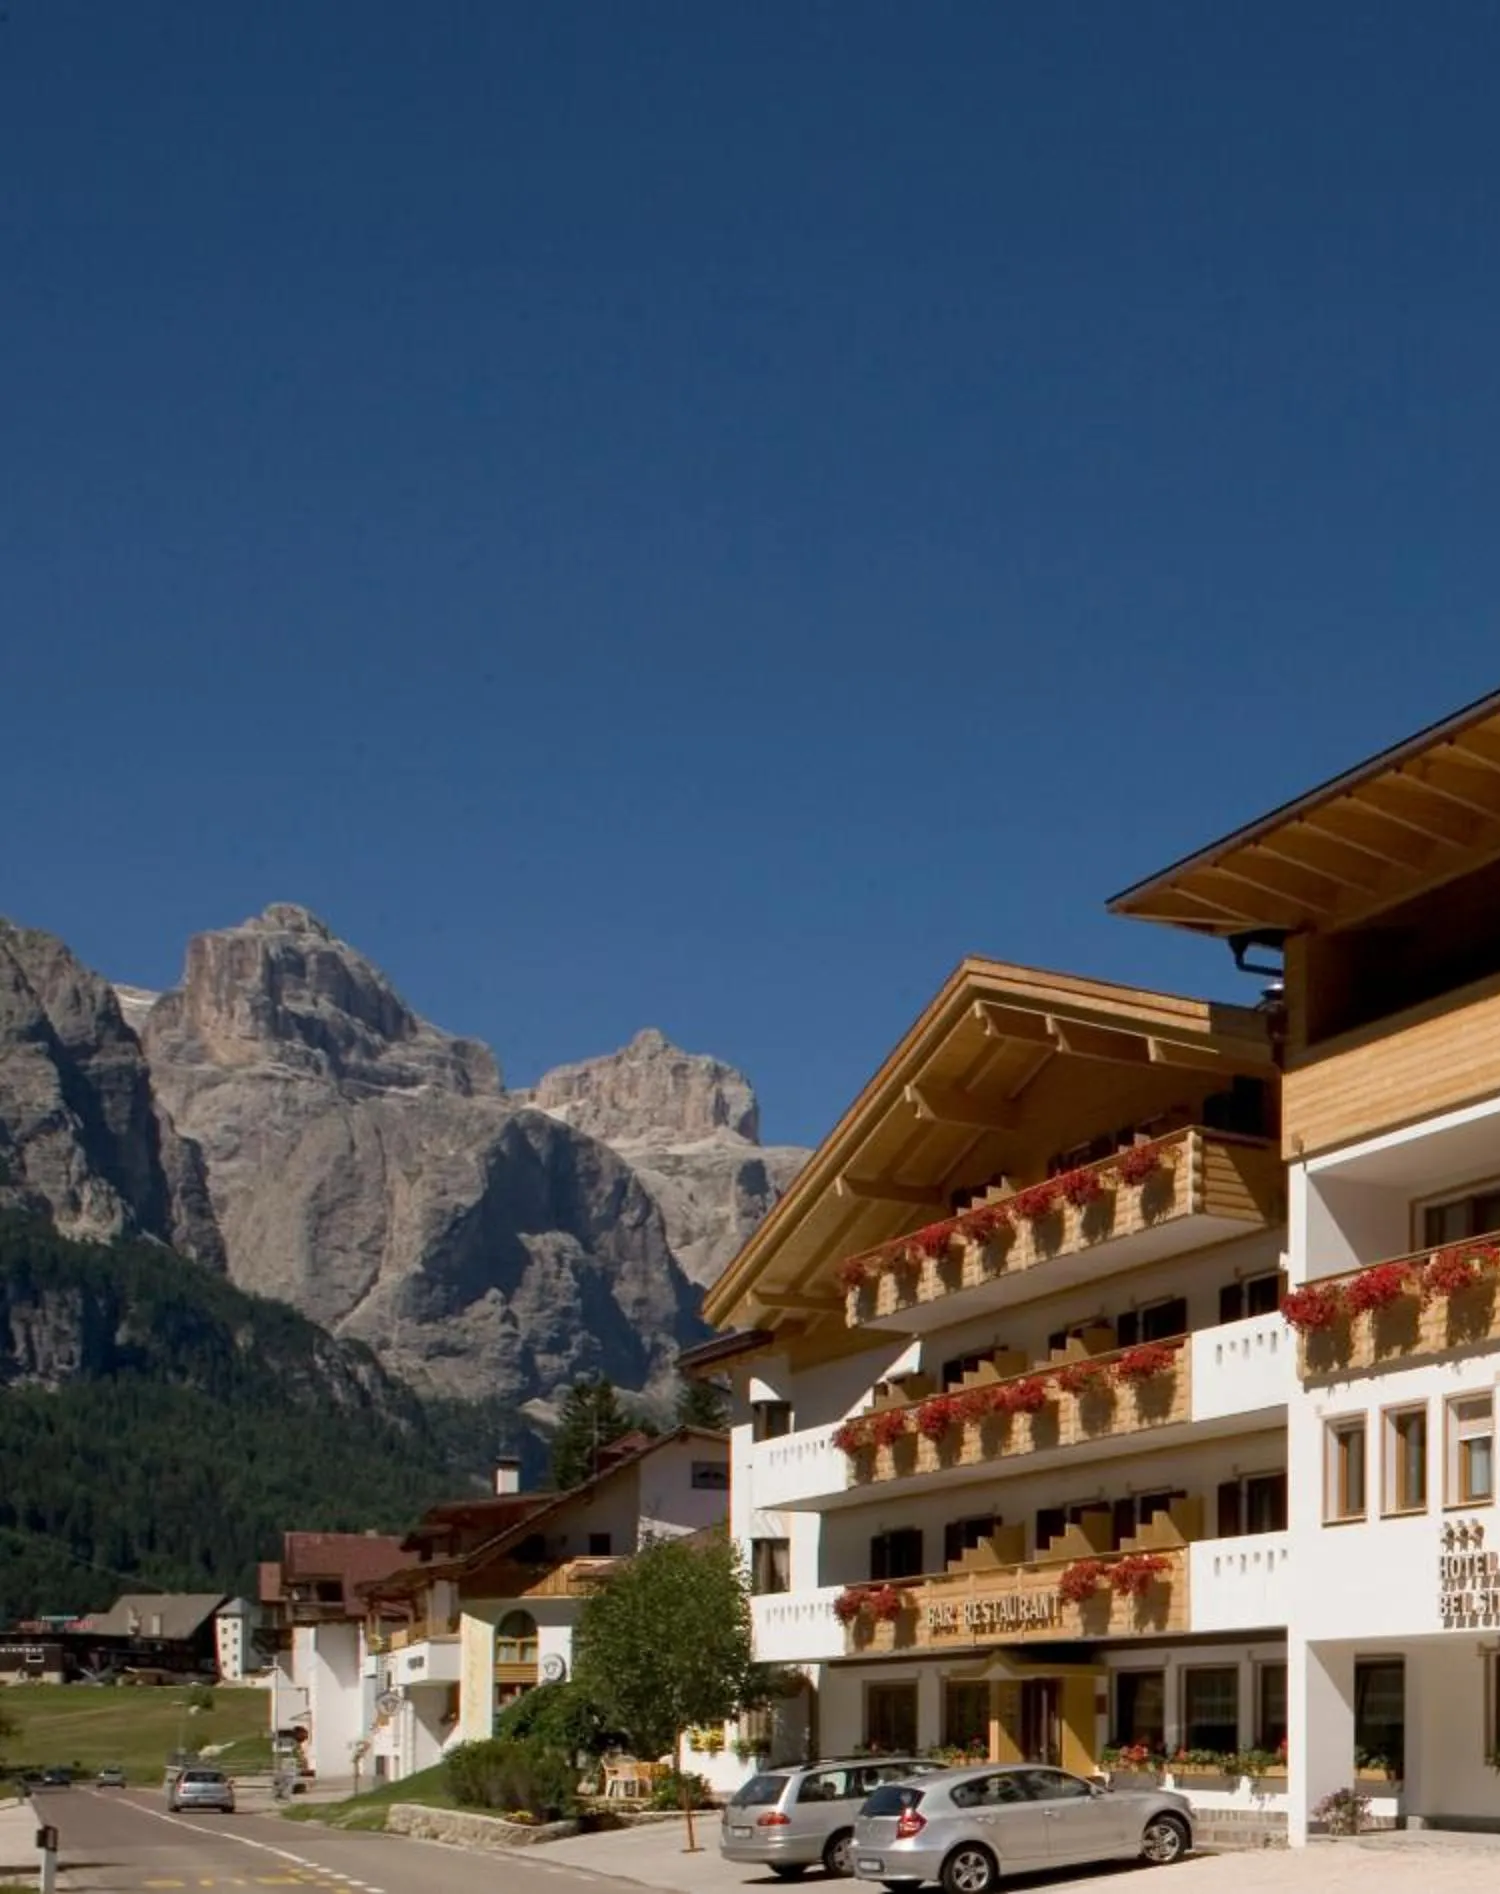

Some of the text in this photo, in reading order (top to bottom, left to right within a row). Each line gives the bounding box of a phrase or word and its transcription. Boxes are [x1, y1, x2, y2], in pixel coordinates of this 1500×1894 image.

[1440, 1552, 1497, 1579] HOTEL
[928, 1591, 1061, 1627] BAR RESTAURANT
[1439, 1591, 1474, 1618] BEL
